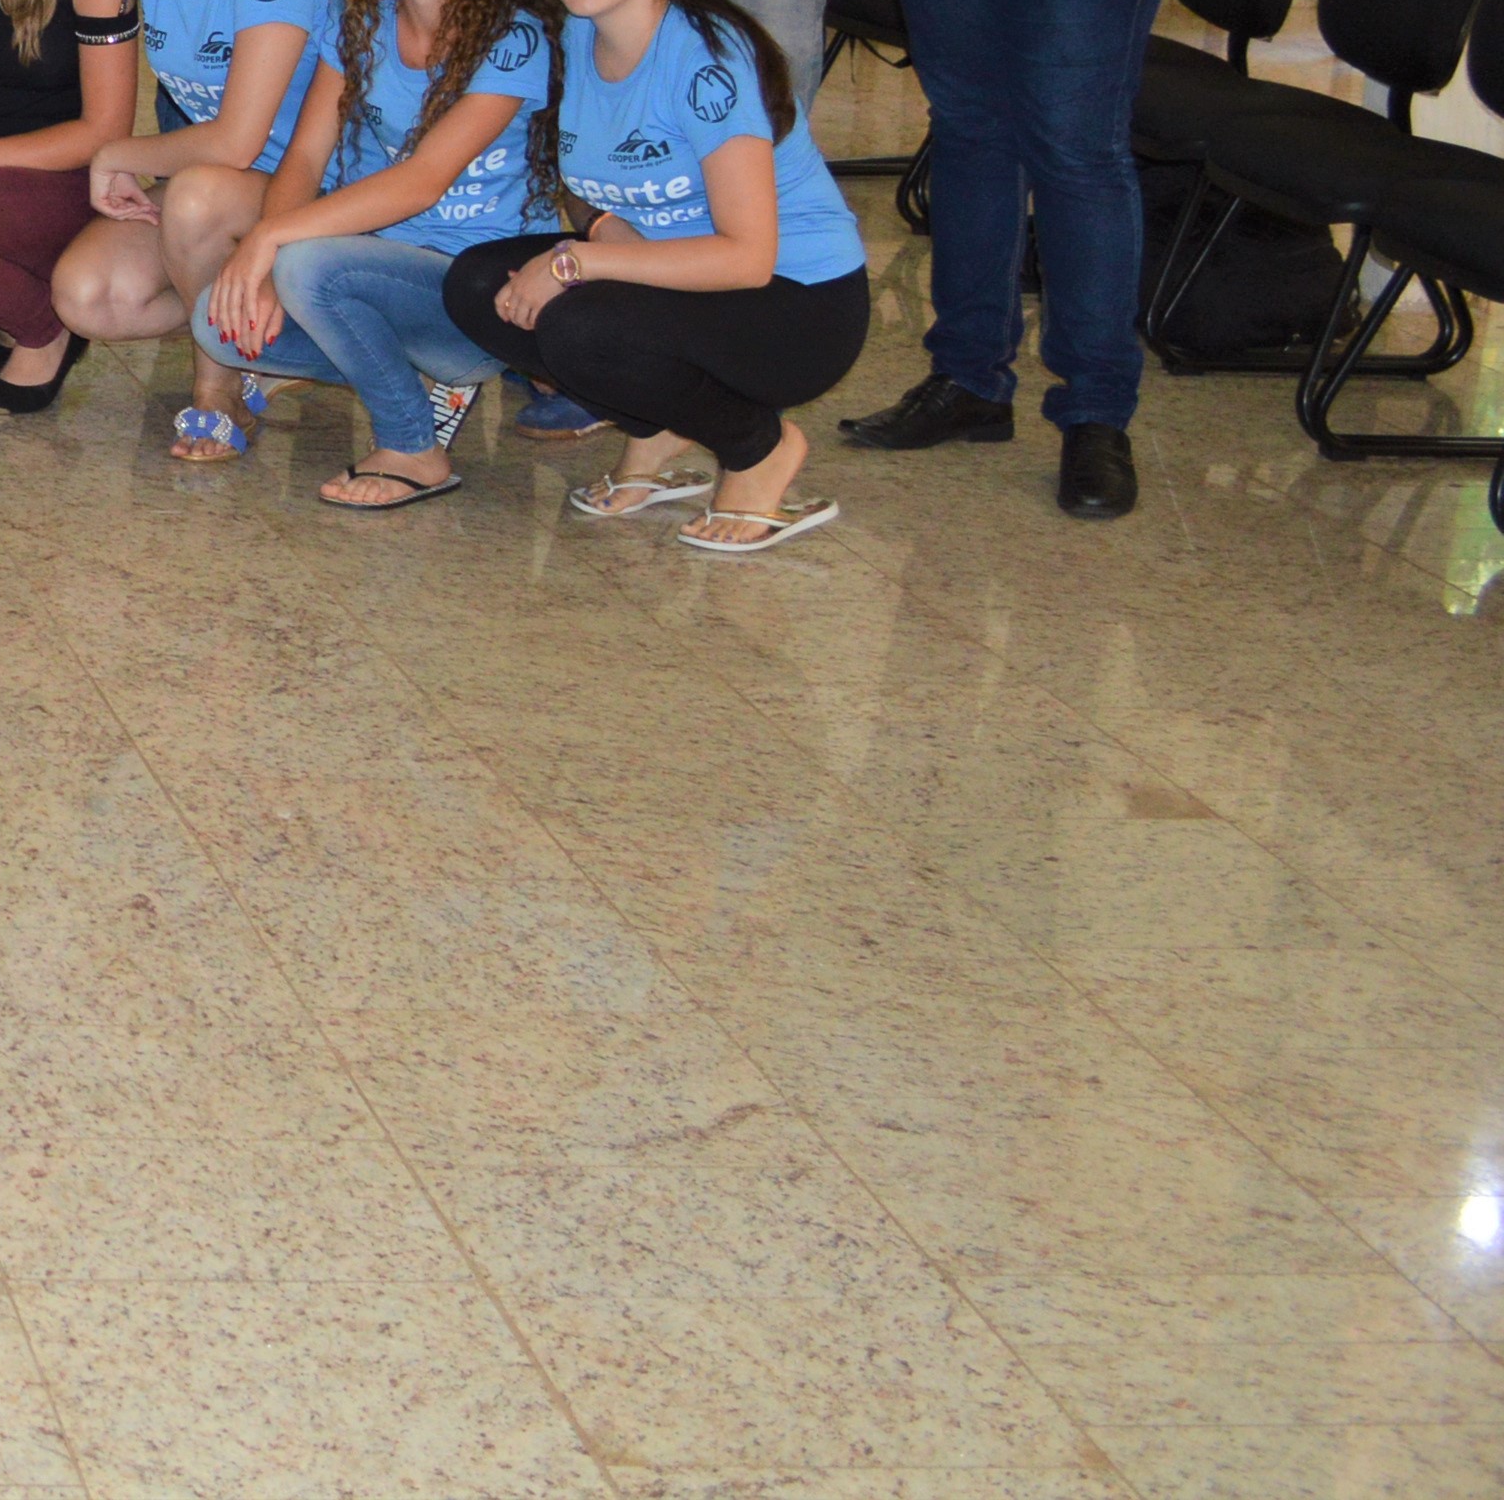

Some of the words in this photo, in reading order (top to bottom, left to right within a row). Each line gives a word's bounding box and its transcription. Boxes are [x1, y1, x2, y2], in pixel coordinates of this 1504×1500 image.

[151, 68, 224, 100] sper
[608, 154, 640, 162] COOPER
[642, 140, 670, 160] A1
[440, 182, 482, 201] ue
[560, 175, 691, 204] sperte
